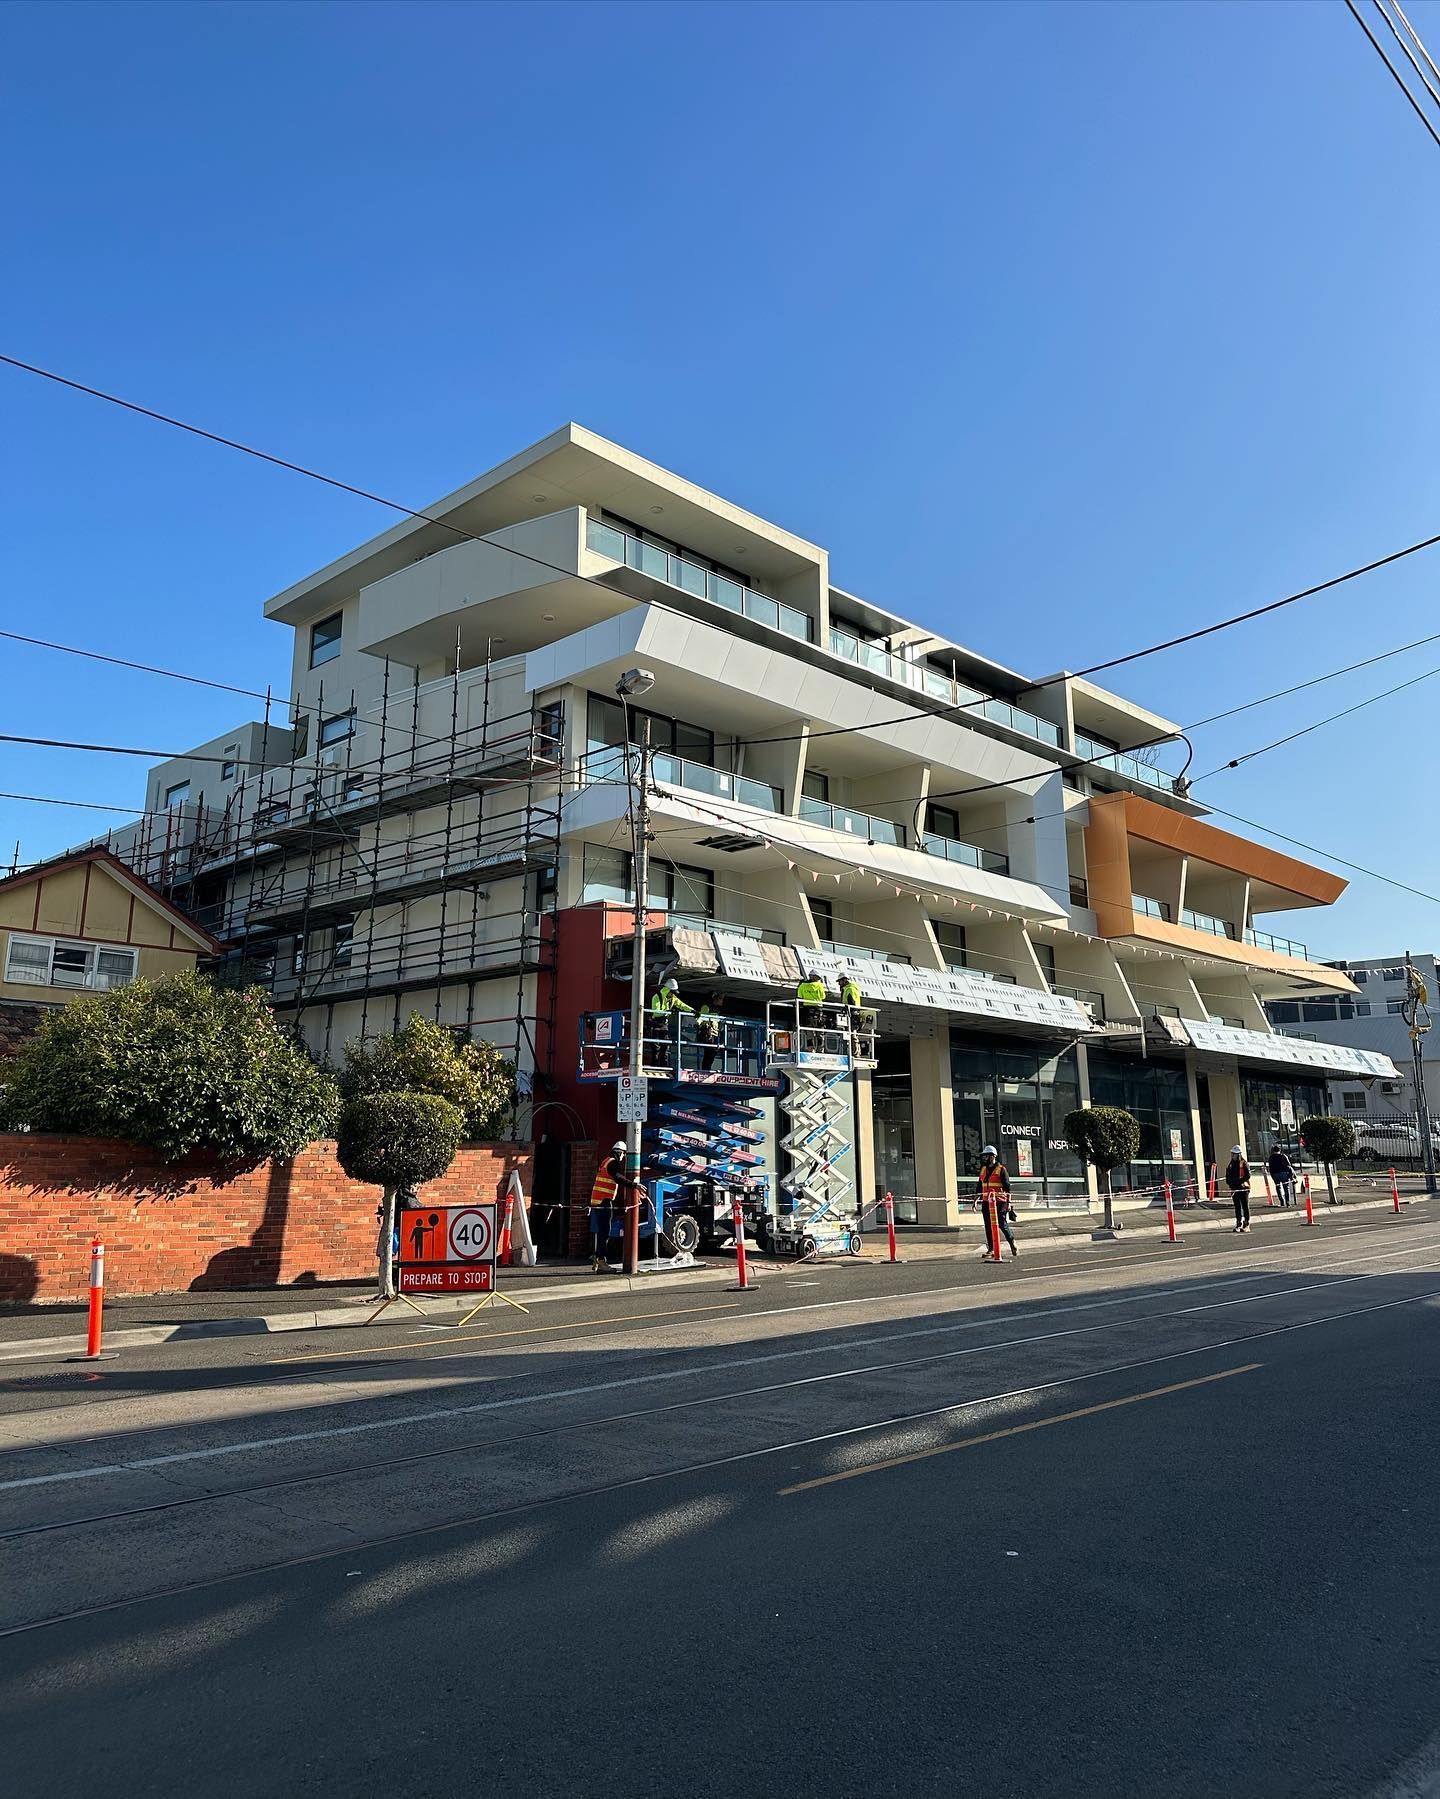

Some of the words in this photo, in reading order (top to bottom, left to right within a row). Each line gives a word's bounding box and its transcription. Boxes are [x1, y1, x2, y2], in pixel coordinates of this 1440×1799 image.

[681, 1070, 716, 1084] ACCESS
[716, 1074, 761, 1086] EQUIPMENT
[761, 1079, 779, 1088] HIRE
[1001, 1124, 1042, 1136] CONNECT
[456, 1223, 484, 1246] 40
[403, 1272, 443, 1286] PREPARE
[448, 1272, 459, 1285] TO
[464, 1272, 487, 1284] STOP
